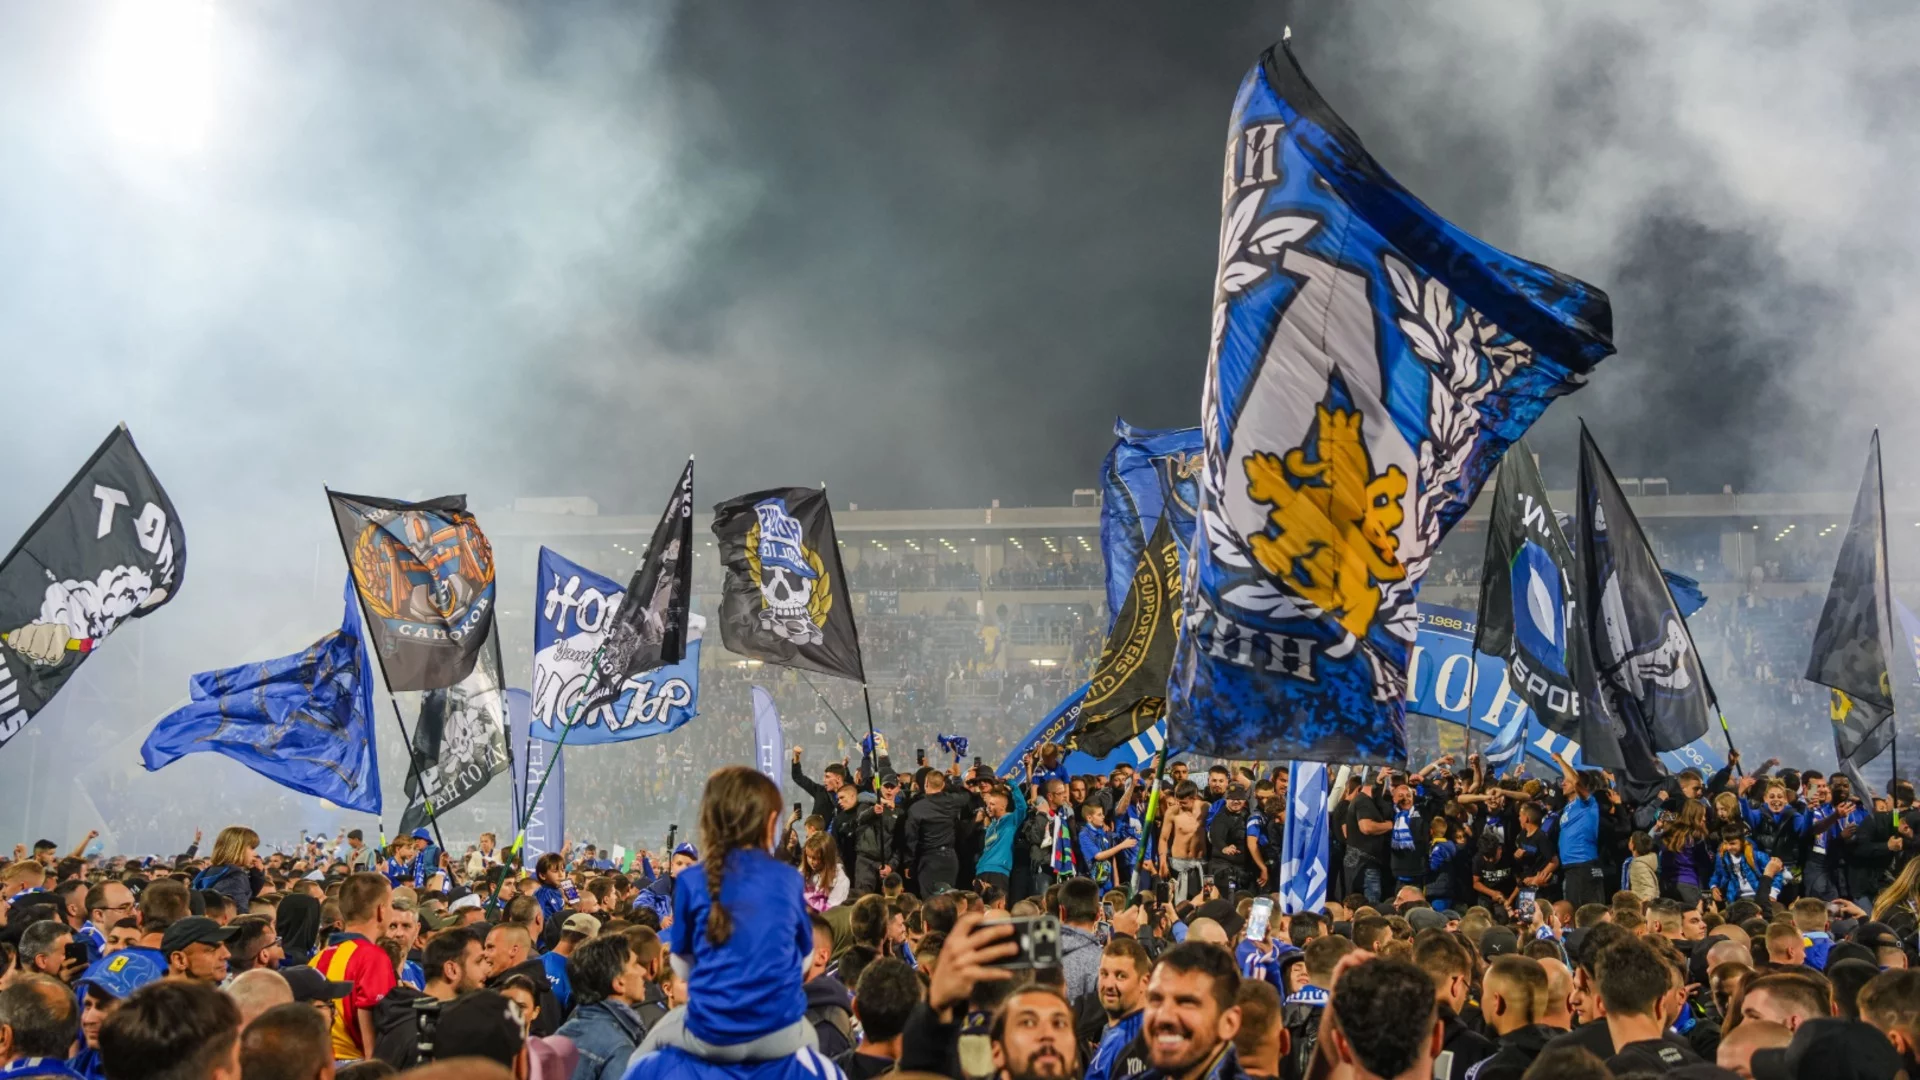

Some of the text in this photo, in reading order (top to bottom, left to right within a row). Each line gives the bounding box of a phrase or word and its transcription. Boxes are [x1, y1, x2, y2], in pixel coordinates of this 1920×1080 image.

[398, 596, 489, 642] САМОКОВ
[1114, 574, 1153, 675] SUPPORTERS
[1428, 615, 1463, 630] 1988
[1041, 717, 1066, 742] 1947
